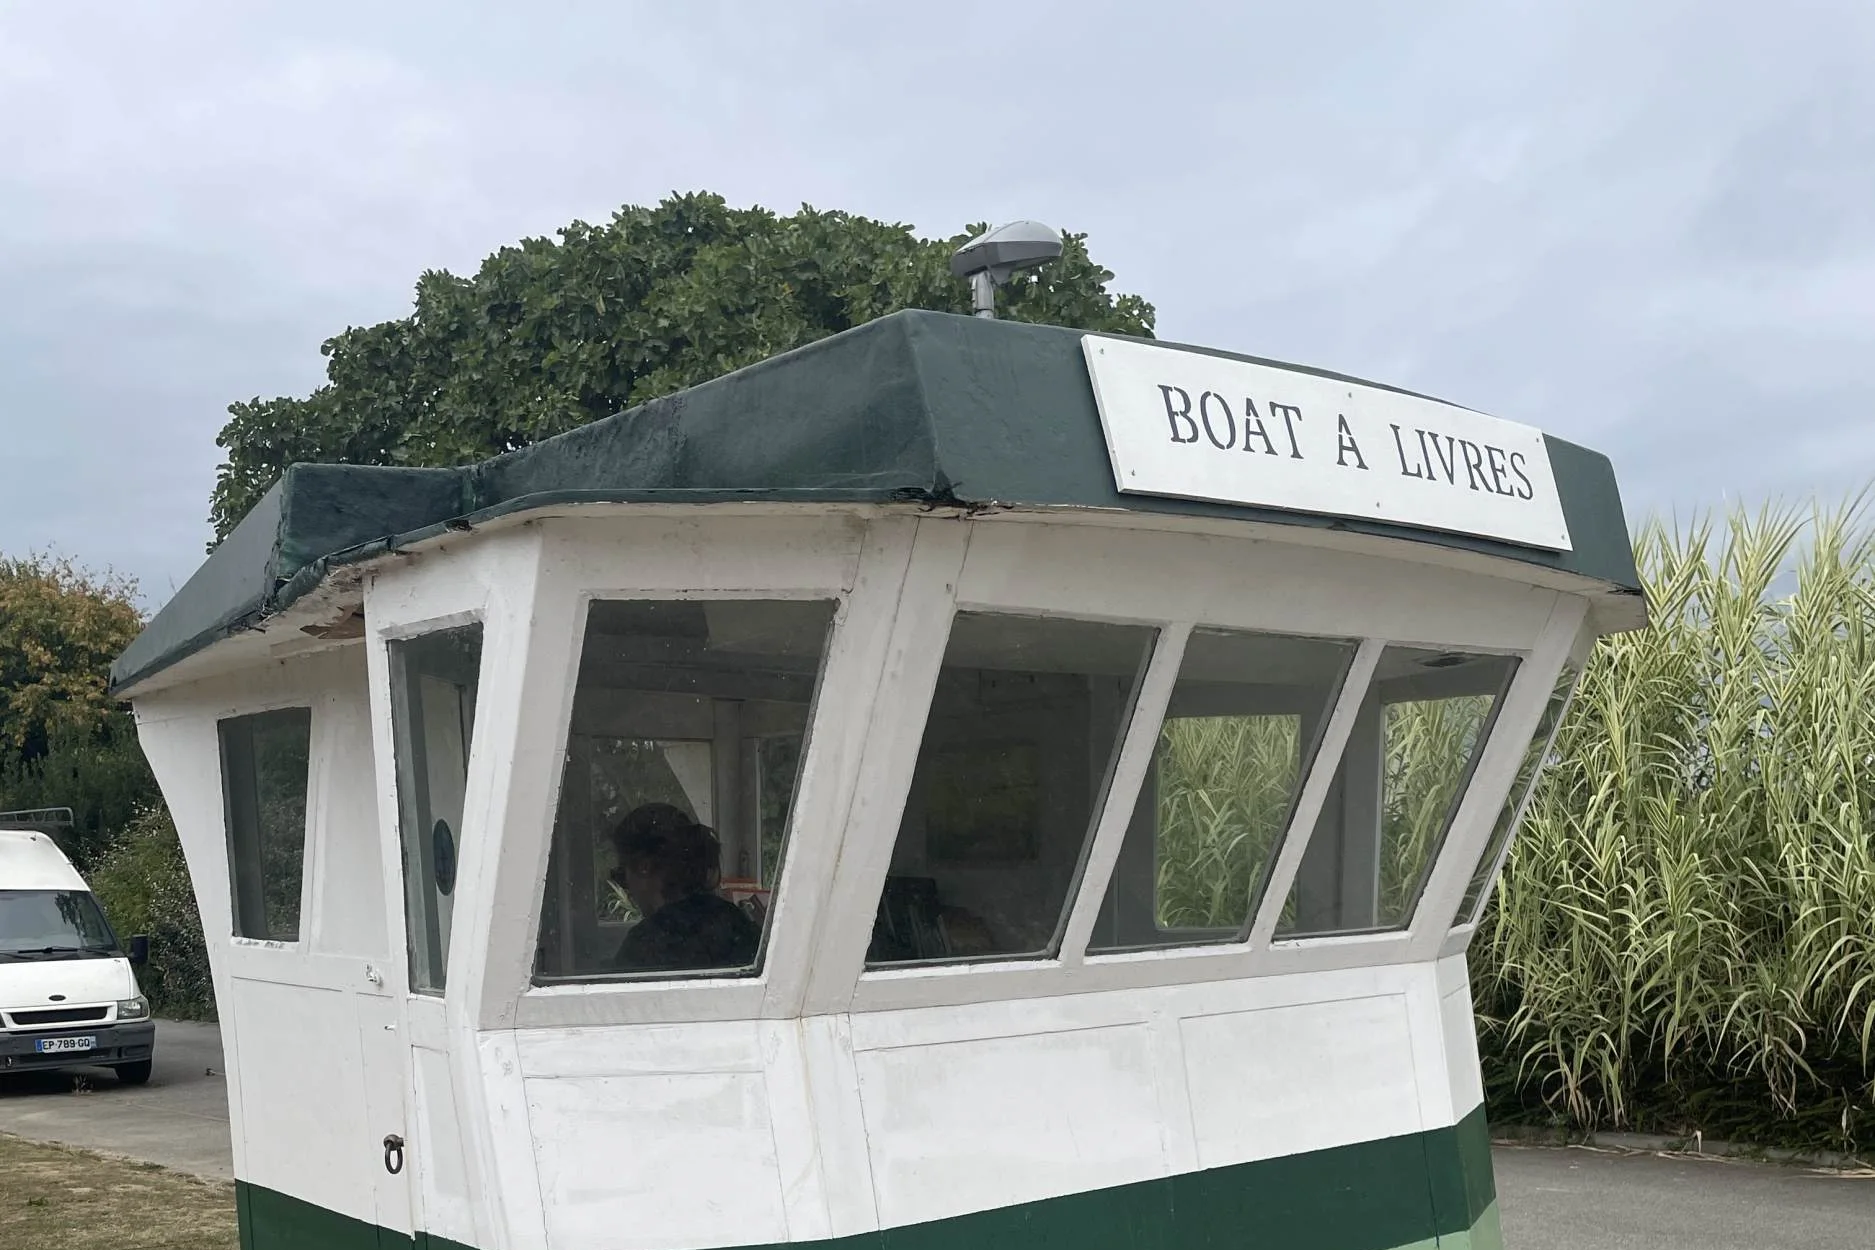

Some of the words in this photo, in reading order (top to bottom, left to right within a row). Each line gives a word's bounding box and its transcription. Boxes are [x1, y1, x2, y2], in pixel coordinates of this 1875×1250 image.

[1157, 384, 1304, 459] BOAT
[1337, 413, 1369, 470] A
[1389, 423, 1534, 500] LIVRES
